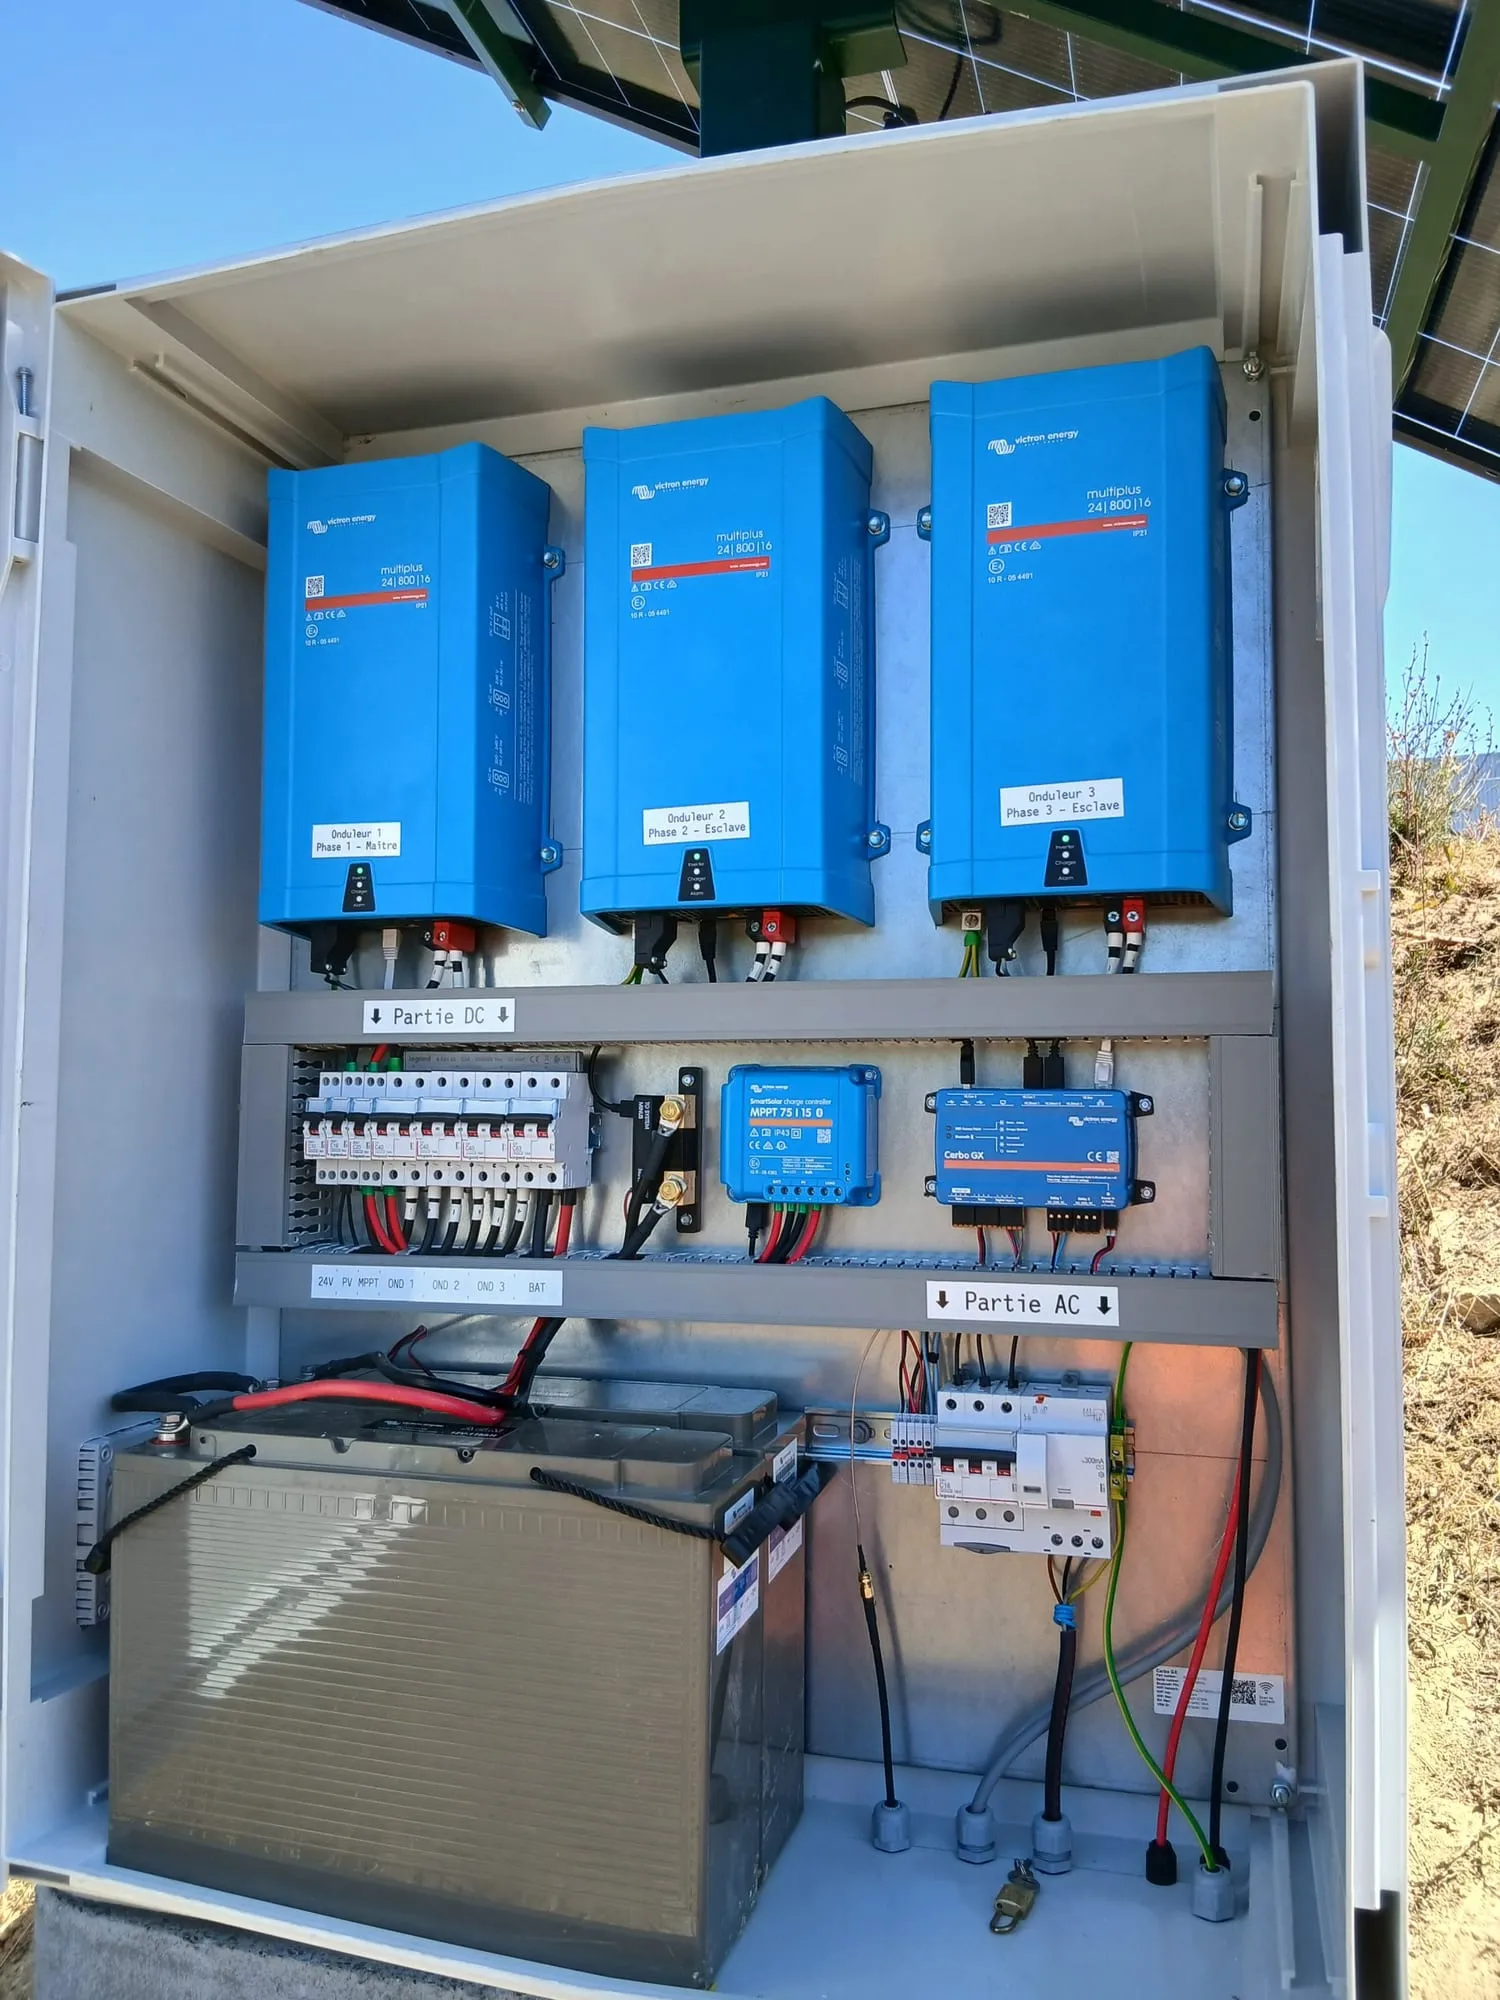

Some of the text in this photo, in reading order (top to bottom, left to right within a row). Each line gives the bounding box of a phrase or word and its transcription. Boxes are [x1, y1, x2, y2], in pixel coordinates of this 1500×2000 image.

[1015, 433, 1045, 444] victron
[1048, 430, 1079, 440] energy
[655, 481, 681, 490] victron
[682, 478, 709, 487] energy
[1087, 485, 1141, 499] multiplus
[327, 517, 351, 526] victron
[352, 514, 376, 522] energy
[716, 529, 763, 542] multiplus
[381, 563, 423, 575] multiplus
[1029, 787, 1095, 802] Onduleur 3
[668, 809, 725, 823] Onduleur 2
[1007, 808, 1039, 818] Phase
[1046, 805, 1052, 815] 3
[1073, 801, 1119, 813] Esclave
[332, 829, 381, 839] Onduleur 1
[649, 828, 677, 838] Phase
[682, 825, 688, 835] 2
[705, 823, 746, 834] Esclave
[317, 842, 341, 852] Phase
[347, 841, 351, 850] 1
[394, 1007, 484, 1024] Partie DC
[783, 1098, 804, 1106] charge
[750, 1107, 778, 1117] MPPT
[780, 1107, 792, 1117] 75
[801, 1108, 812, 1117] 15
[944, 1151, 984, 1159] Cerbo GX
[318, 1277, 546, 1293] 24V PV MPPT OND 1 OND 2 OND 3 BAT
[965, 1291, 1080, 1315] Partie AC
